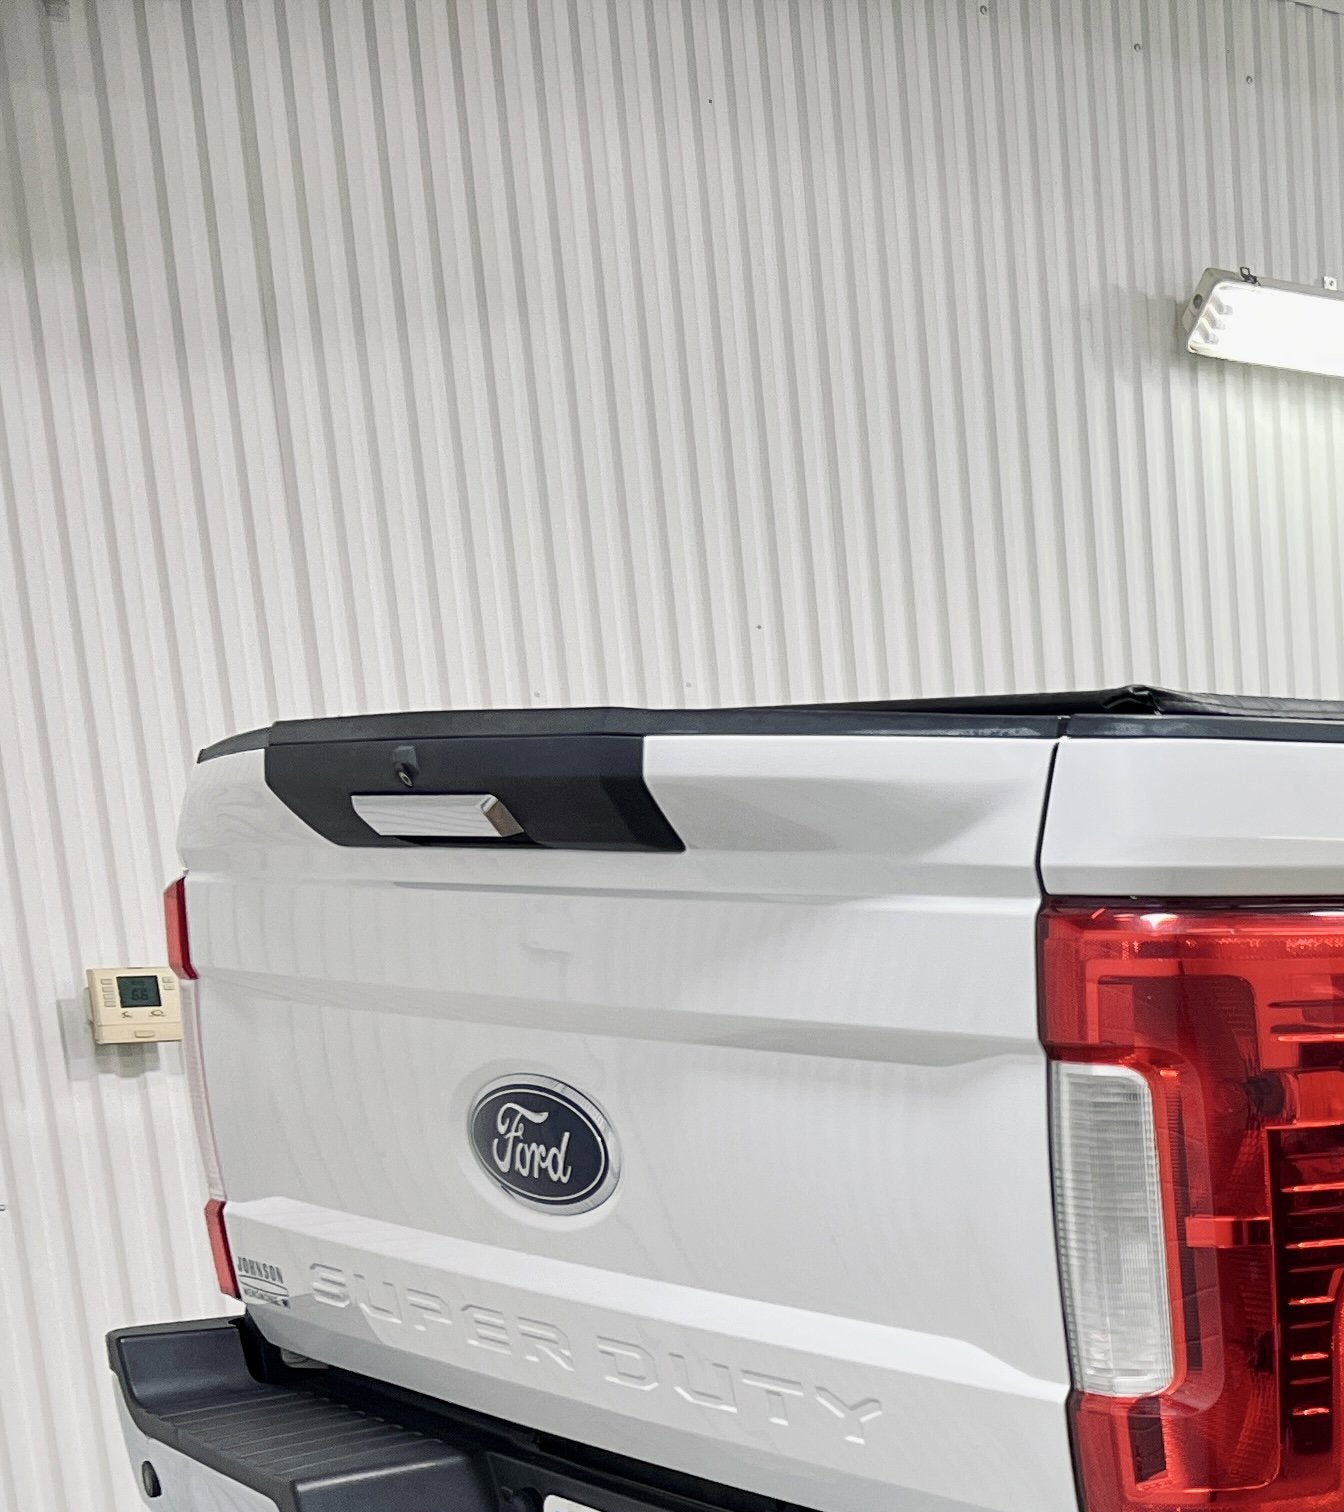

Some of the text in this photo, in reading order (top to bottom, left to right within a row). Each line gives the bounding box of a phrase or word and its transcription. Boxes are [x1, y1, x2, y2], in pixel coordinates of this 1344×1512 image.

[492, 1102, 571, 1183] Ford
[237, 1256, 283, 1284] JOHNSON
[310, 1263, 883, 1446] SUPER DUTY
